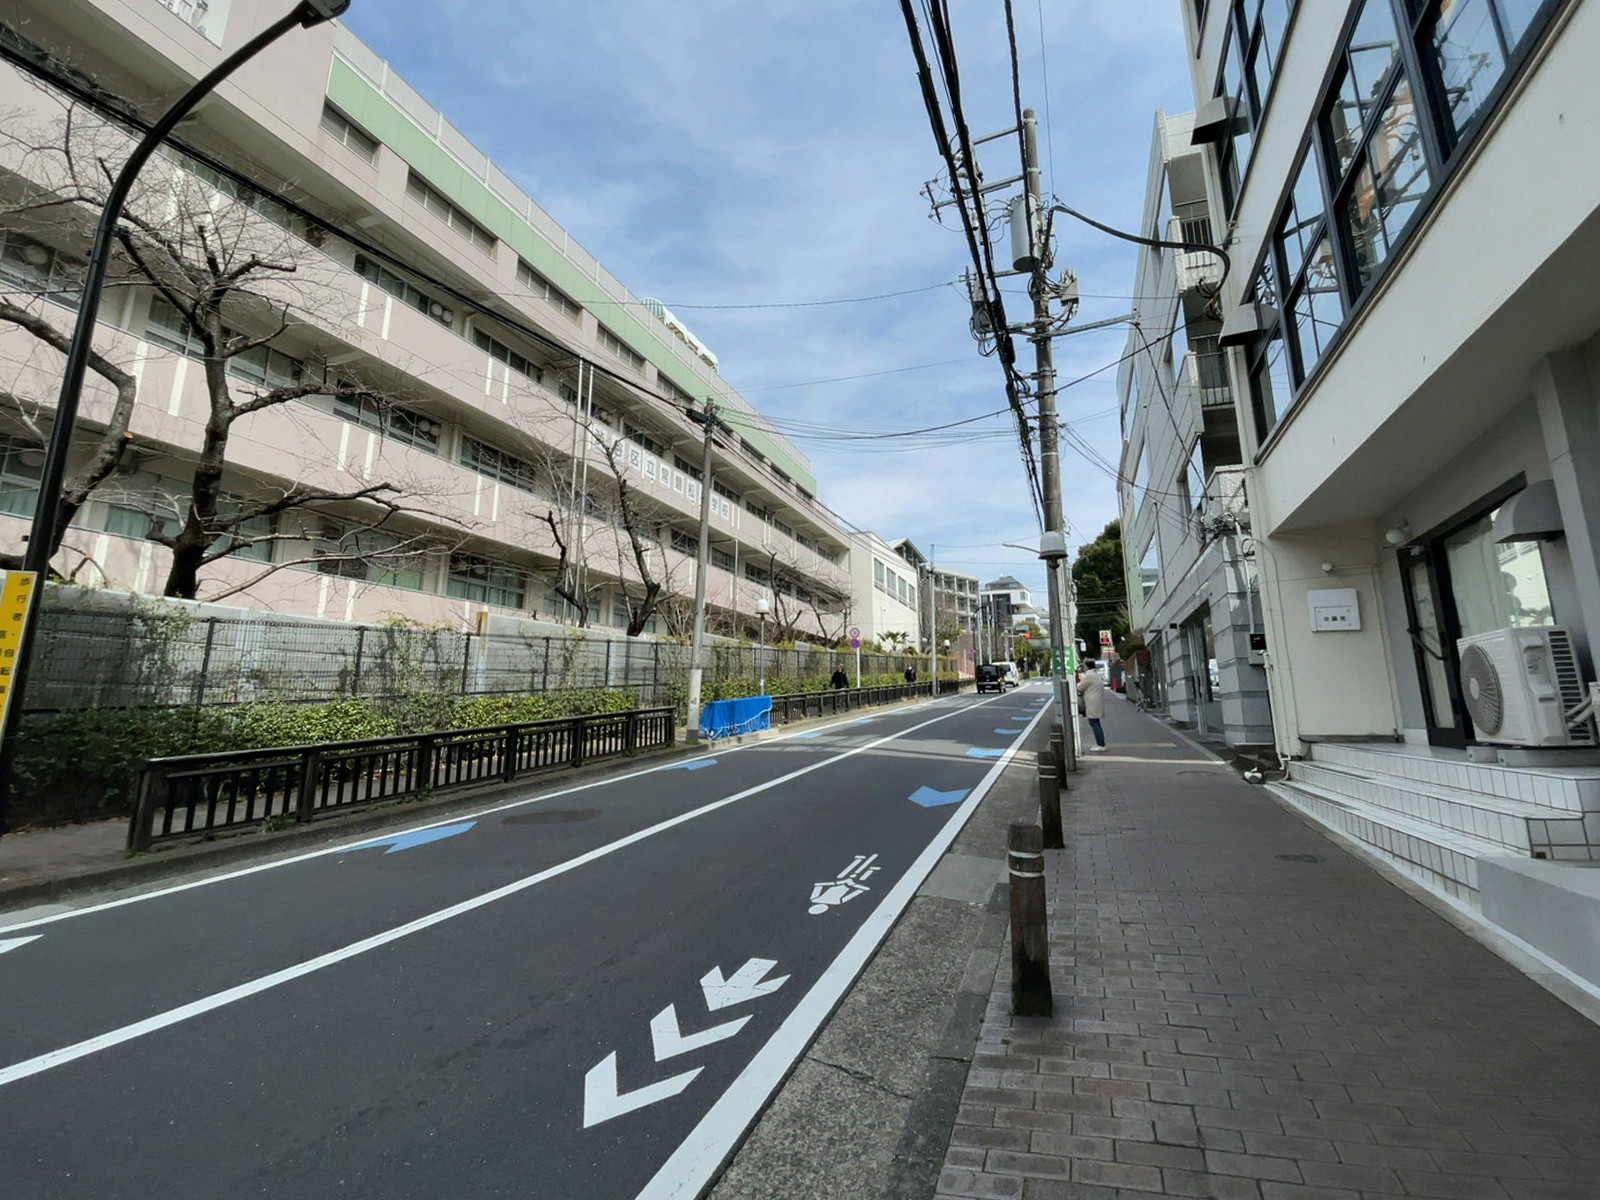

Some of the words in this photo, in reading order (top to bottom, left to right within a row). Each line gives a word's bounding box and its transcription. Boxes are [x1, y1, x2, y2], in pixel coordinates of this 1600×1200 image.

[593, 427, 729, 517] 渋谷区立常磐松学校
[0, 576, 31, 713] 歩行者・自転車
